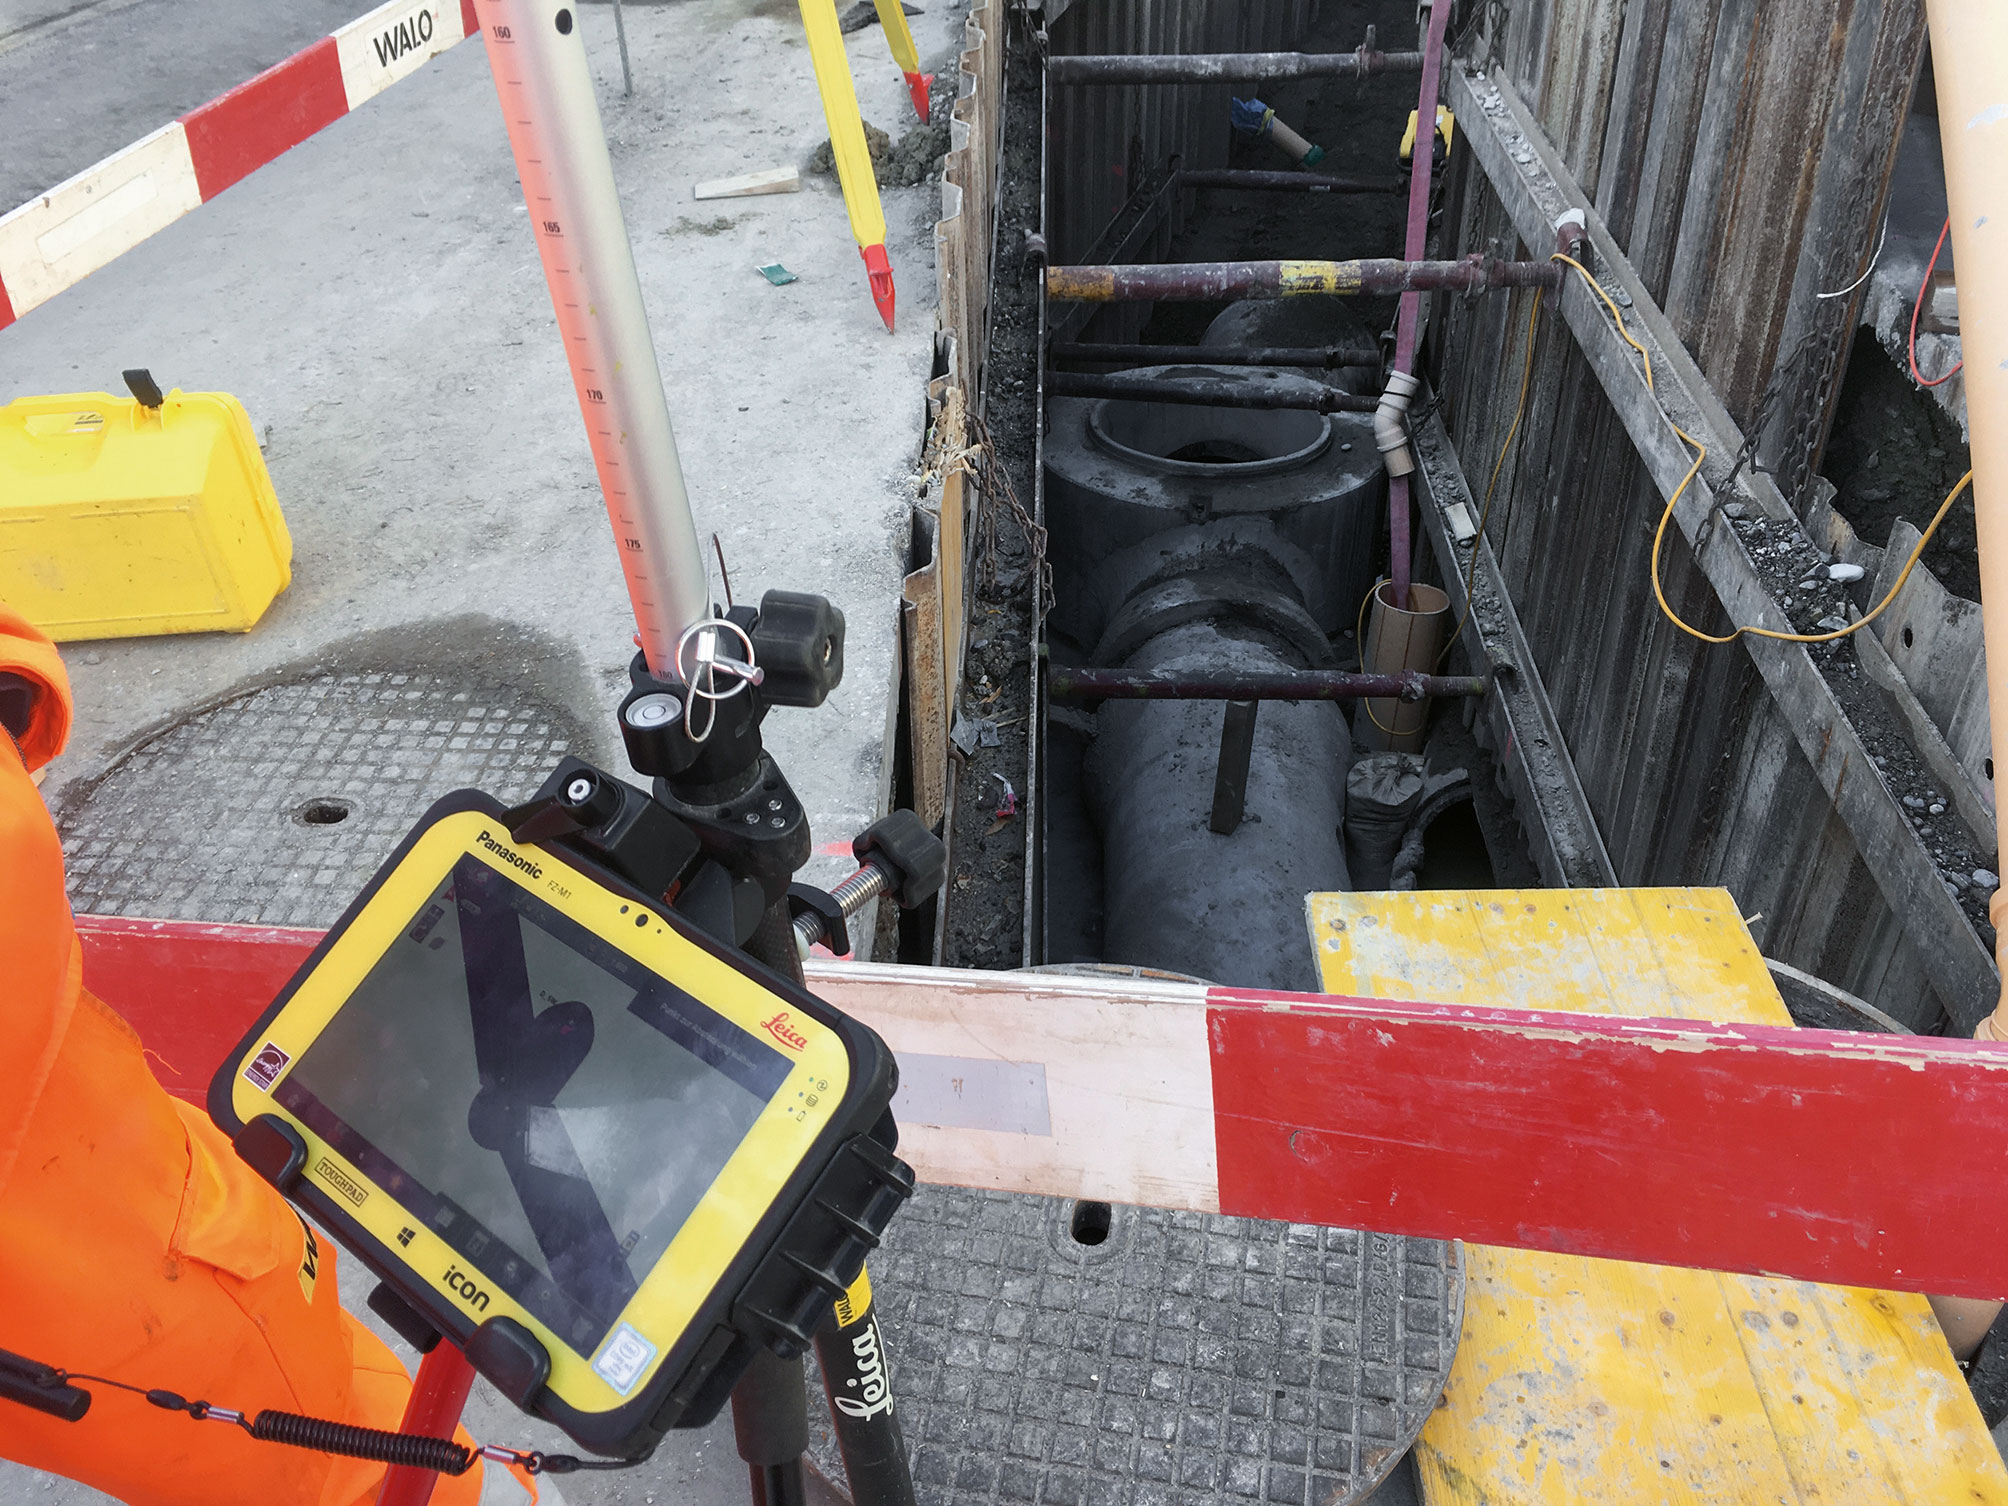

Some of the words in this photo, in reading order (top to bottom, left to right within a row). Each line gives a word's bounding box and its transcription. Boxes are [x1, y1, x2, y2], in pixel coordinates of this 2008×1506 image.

[373, 9, 433, 68] WALO
[493, 26, 511, 39] 160
[543, 221, 560, 233] 165
[586, 388, 603, 400] 170
[625, 538, 641, 549] 175
[476, 830, 543, 880] Panasonic
[547, 880, 573, 900] FZ-M1
[760, 1012, 808, 1052] Leica
[319, 1161, 364, 1202] TOUGHPAD
[834, 1313, 894, 1422] Leica
